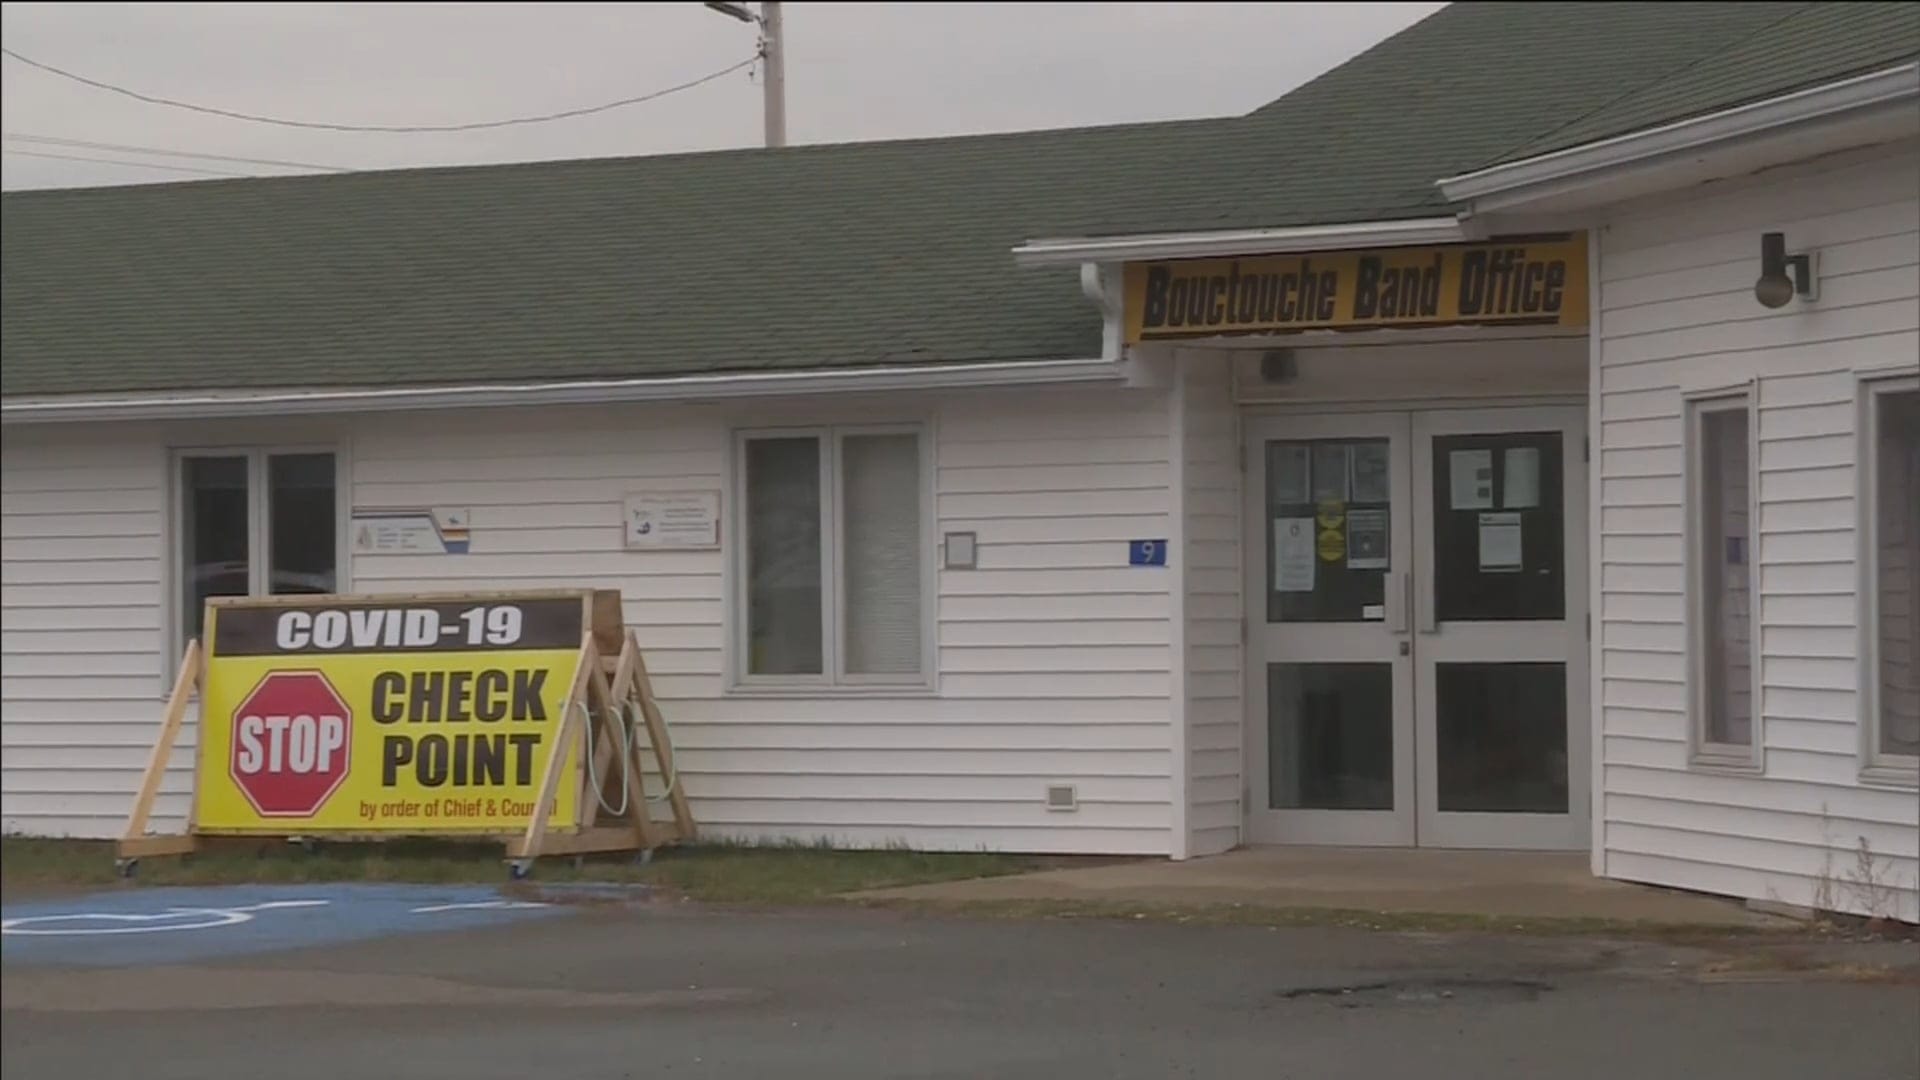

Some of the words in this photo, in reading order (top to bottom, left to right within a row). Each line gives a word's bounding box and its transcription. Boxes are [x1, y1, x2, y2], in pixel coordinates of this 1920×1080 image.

[1142, 259, 1338, 327] Bouctouche
[1353, 252, 1442, 319] Band
[1459, 248, 1566, 314] Office
[1142, 542, 1154, 562] 9
[276, 606, 522, 648] COVID-19
[371, 669, 549, 724] CHECK
[238, 715, 344, 773] STOP
[382, 733, 541, 787] POINT
[360, 801, 376, 820] by
[381, 800, 420, 817] order
[425, 800, 439, 816] of
[444, 799, 481, 816] Chief
[486, 800, 496, 816] &
